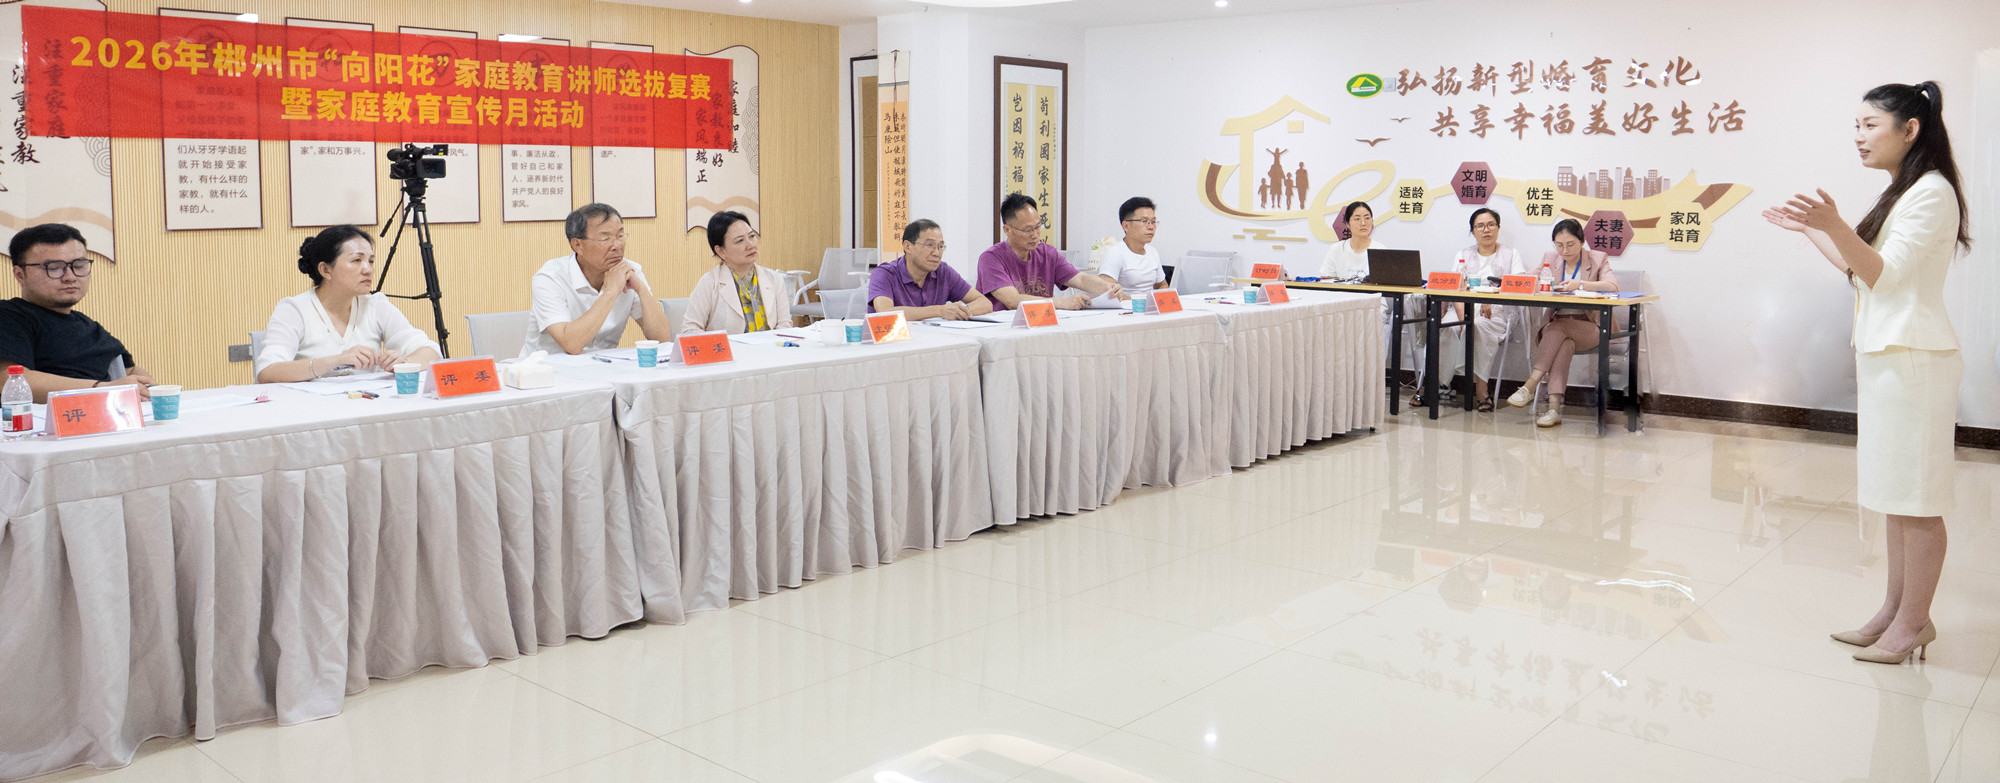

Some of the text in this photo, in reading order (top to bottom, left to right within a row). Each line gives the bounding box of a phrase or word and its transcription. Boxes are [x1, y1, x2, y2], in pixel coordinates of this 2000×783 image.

[1397, 55, 1703, 97] 弘扬新型婚育文化
[281, 87, 584, 129] 暨家庭教育宣传月活动
[1430, 99, 1747, 140] 共享幸福美好生活
[177, 145, 247, 155] 们从牙牙学语起
[1012, 92, 1025, 194] 岂因祸福
[178, 160, 248, 170] 就开始接受家
[1461, 169, 1488, 183] 文明
[512, 187, 564, 196] 共产党人的良好
[1399, 186, 1424, 199] 适龄
[1461, 185, 1488, 198] 婚育
[1526, 187, 1554, 201] 优生
[180, 204, 215, 214] 样的人。
[1399, 202, 1424, 215] 生育
[1526, 203, 1554, 217] 优育
[1594, 218, 1624, 233] 夫妻
[1670, 211, 1701, 226] 家风
[1594, 235, 1623, 249] 共育
[1669, 228, 1701, 243] 培育
